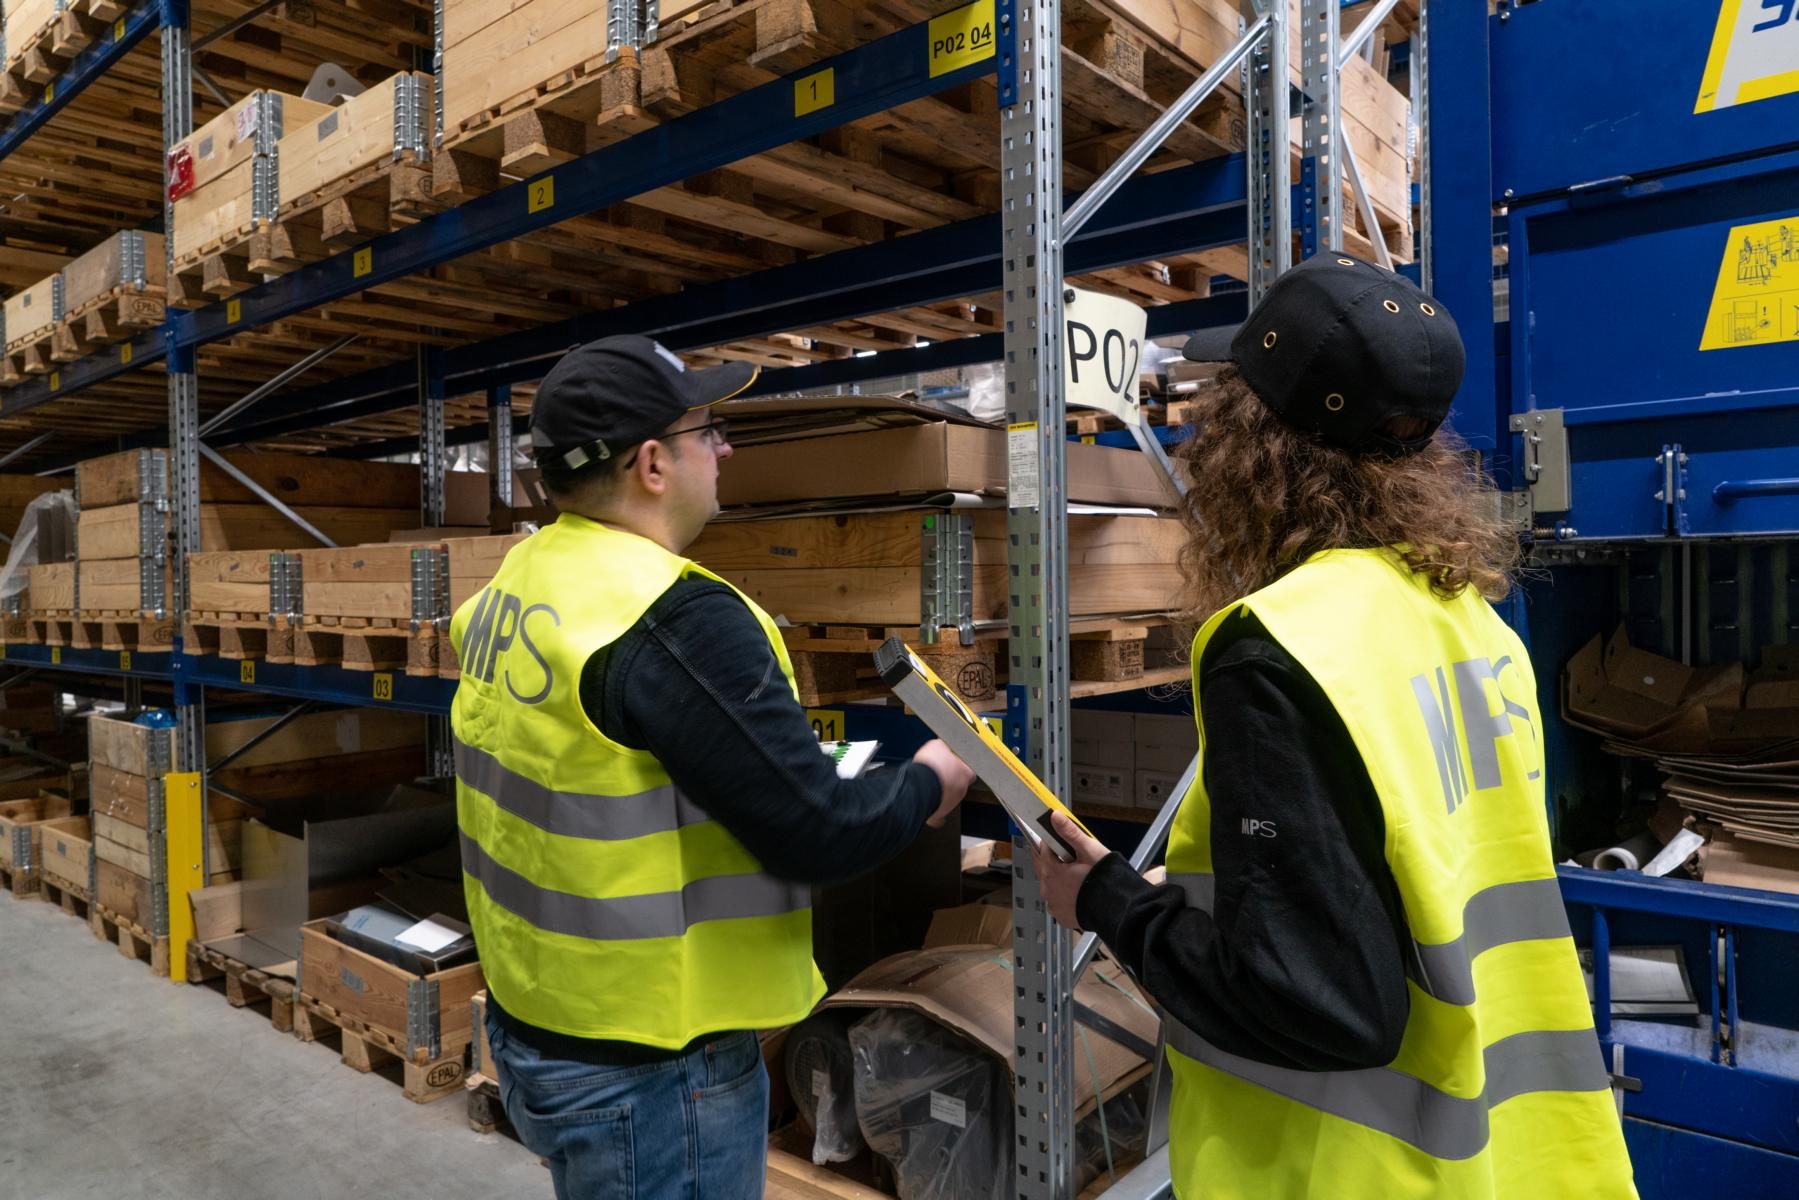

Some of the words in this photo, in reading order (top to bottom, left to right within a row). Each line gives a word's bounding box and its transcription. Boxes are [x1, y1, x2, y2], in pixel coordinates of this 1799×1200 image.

[933, 33, 965, 60] P02
[970, 23, 991, 47] 04
[810, 79, 818, 102] 1
[536, 186, 545, 205] 2
[358, 255, 366, 271] 3
[1067, 319, 1139, 404] P02
[462, 586, 561, 704] MPS
[242, 665, 254, 681] 04
[962, 668, 987, 692] EPAL
[374, 678, 390, 698] 03
[1410, 655, 1541, 816] MPS
[1241, 817, 1278, 839] MPS
[432, 1066, 458, 1086] EPAL
